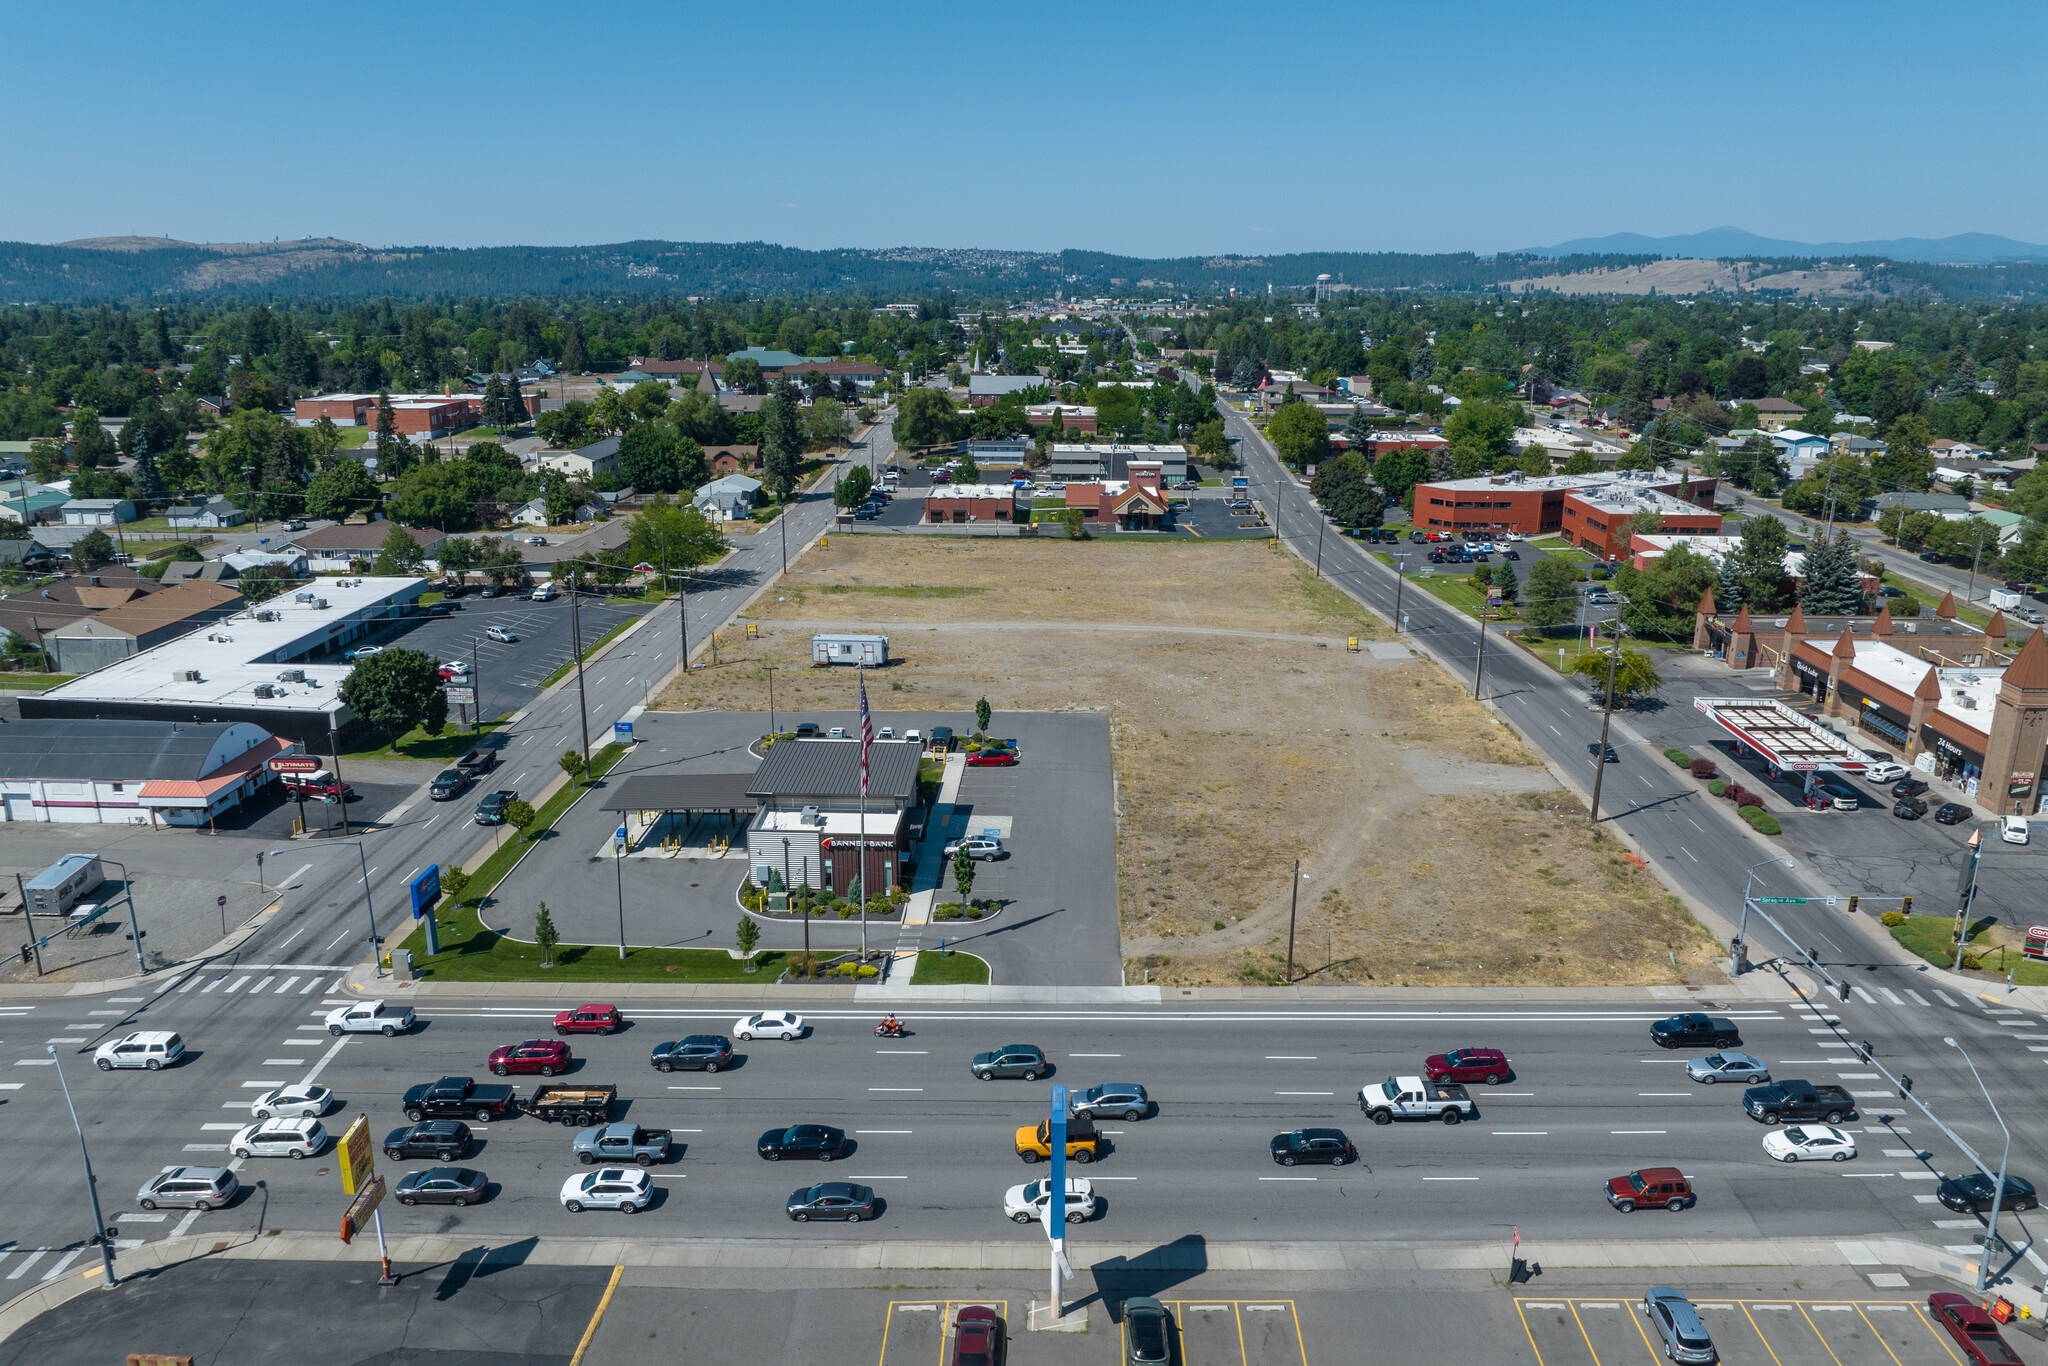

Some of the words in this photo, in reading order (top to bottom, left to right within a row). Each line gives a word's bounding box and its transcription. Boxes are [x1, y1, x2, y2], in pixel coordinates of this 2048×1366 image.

[1797, 661, 1808, 672] Quick
[1938, 738, 1946, 746] 24
[1946, 742, 1962, 756] Hours
